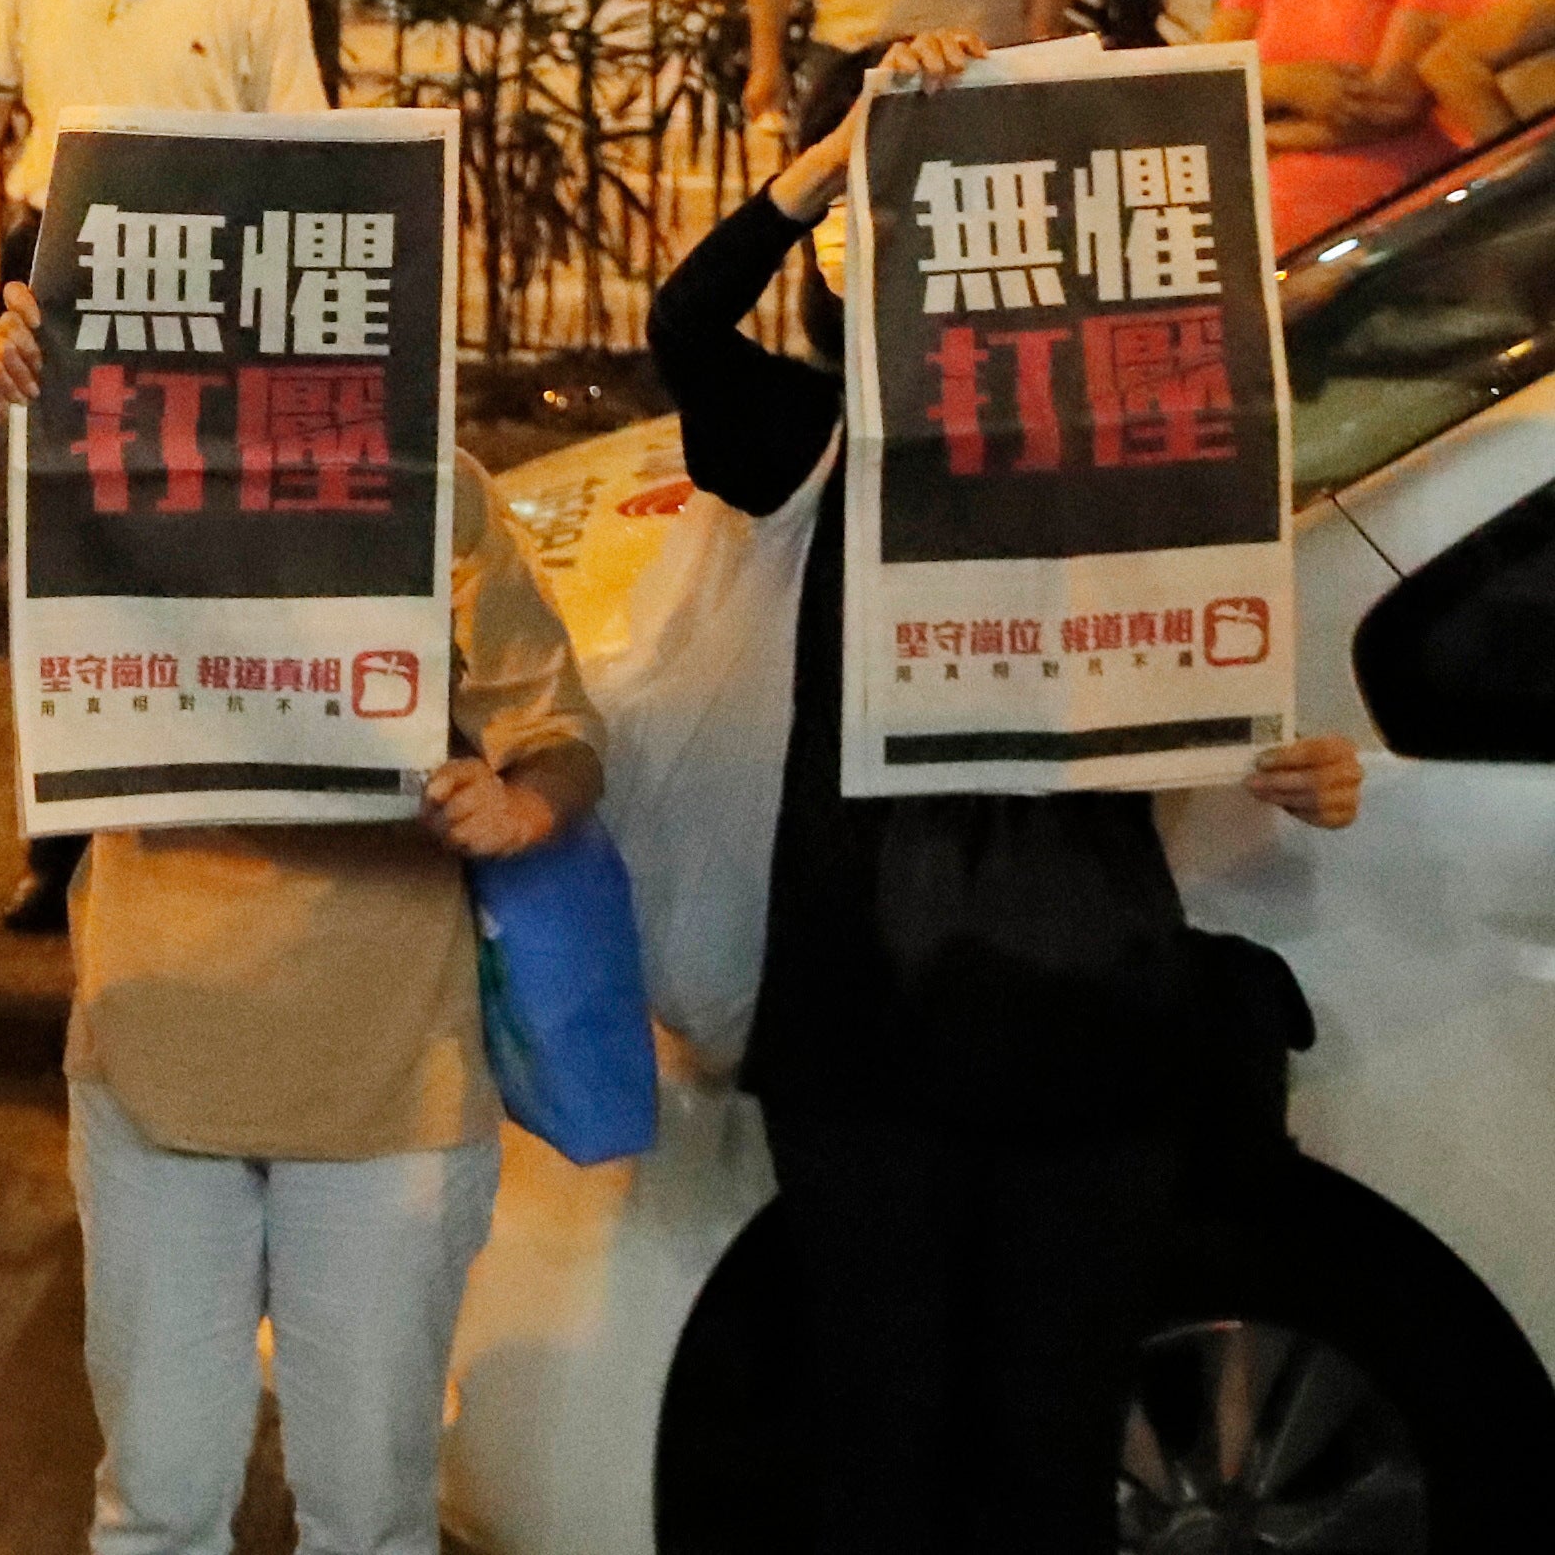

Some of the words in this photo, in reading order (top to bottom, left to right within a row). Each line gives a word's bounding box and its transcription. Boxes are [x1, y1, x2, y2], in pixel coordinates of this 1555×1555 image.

[74, 203, 396, 356] 無懼
[912, 144, 1223, 314] 無懼
[70, 363, 392, 514] 打壓
[926, 305, 1238, 477] 打壓
[39, 653, 180, 693] 堅守崗位
[196, 655, 342, 693] 報道真相
[894, 618, 1042, 658] 堅守崗位
[1060, 607, 1193, 653] 報道真相
